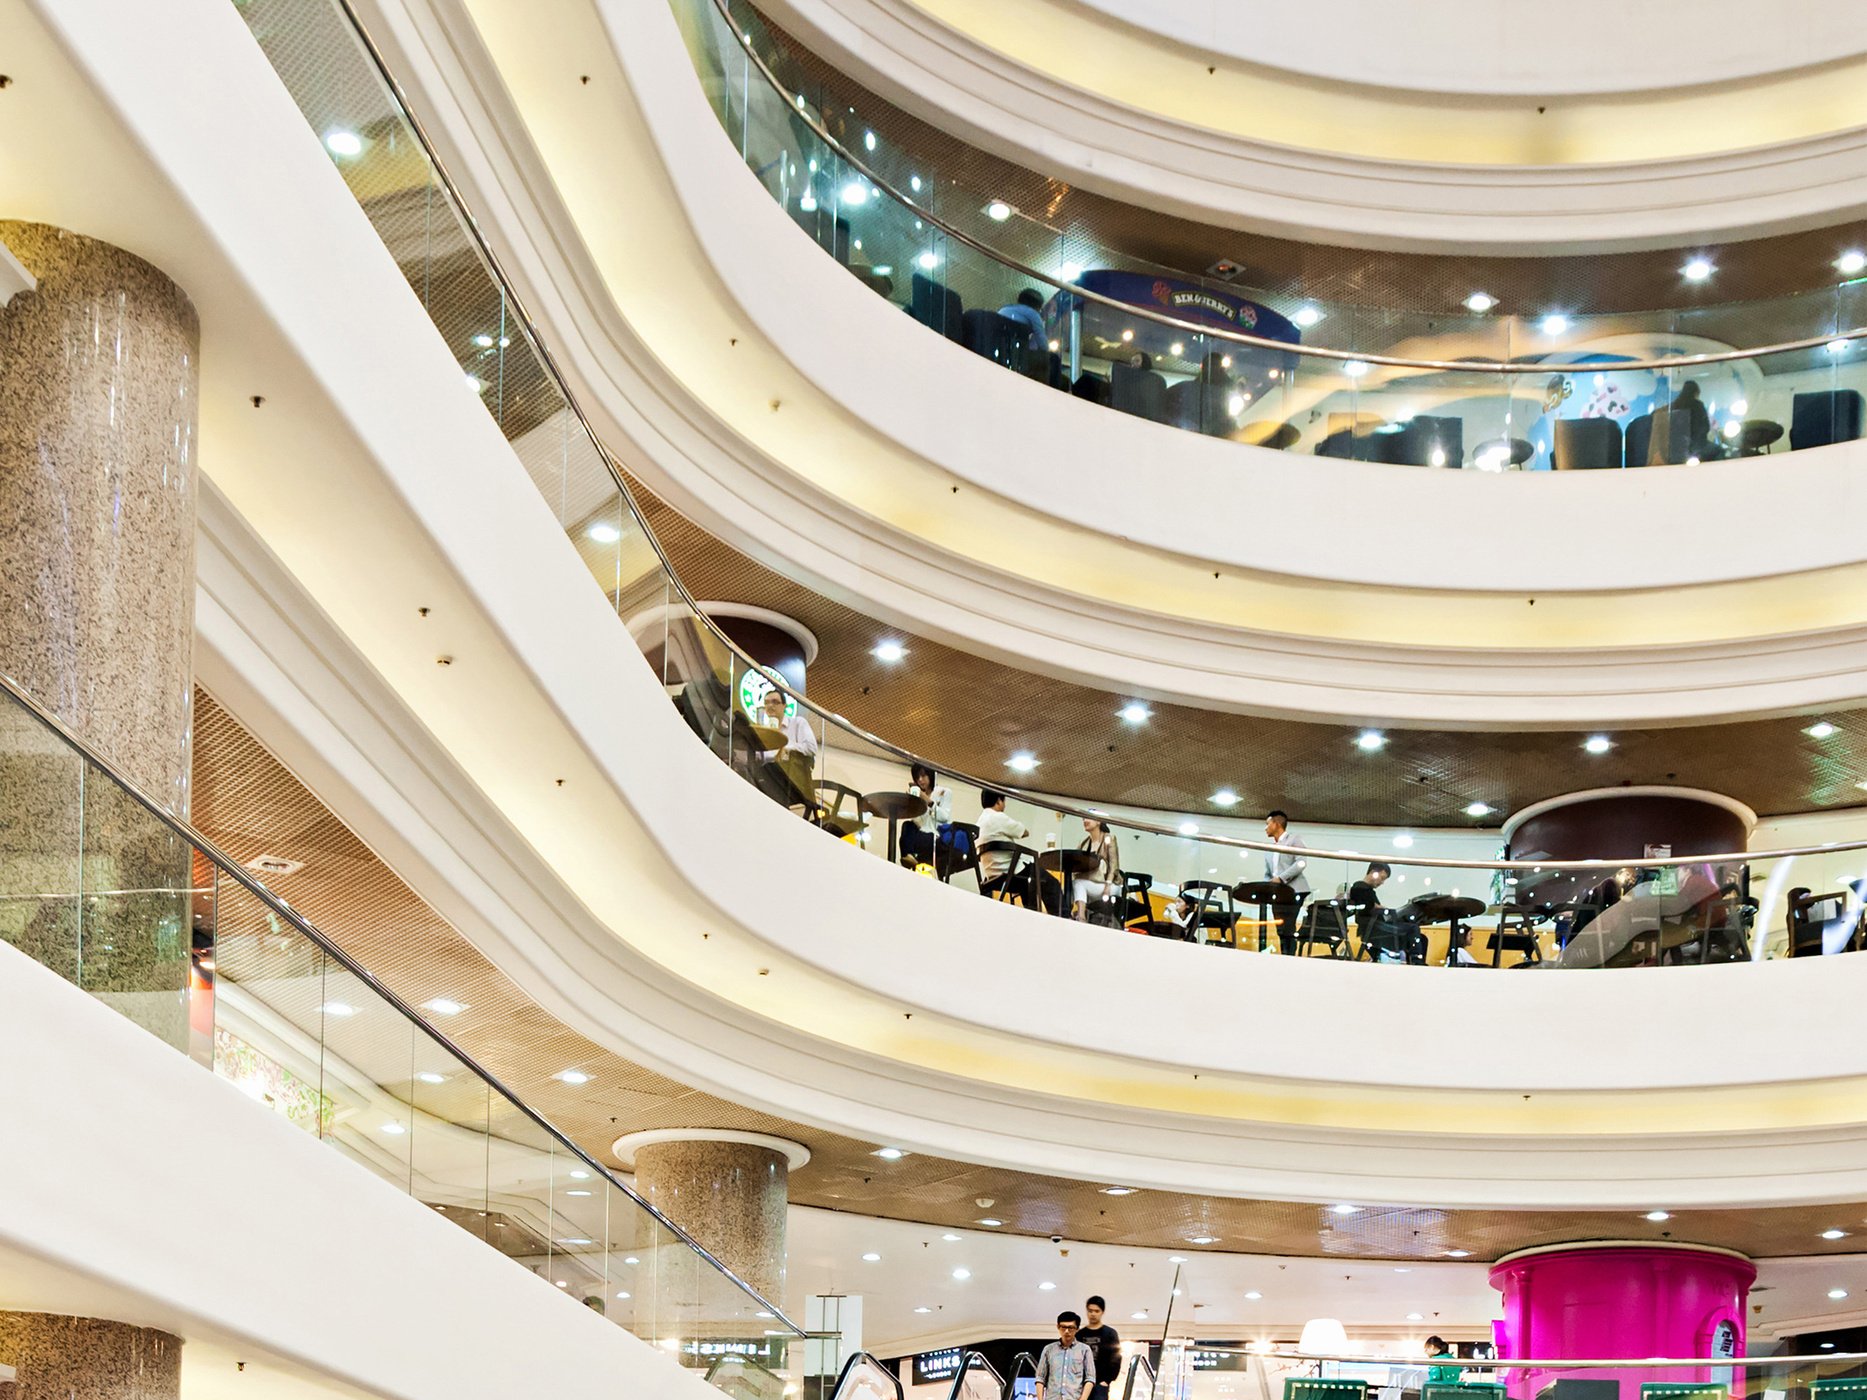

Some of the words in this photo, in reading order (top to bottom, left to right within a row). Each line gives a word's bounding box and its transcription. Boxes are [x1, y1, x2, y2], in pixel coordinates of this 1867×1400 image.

[1174, 294, 1193, 304] BEN
[1201, 295, 1234, 319] JERRY'S
[920, 1355, 961, 1373] LINKS
